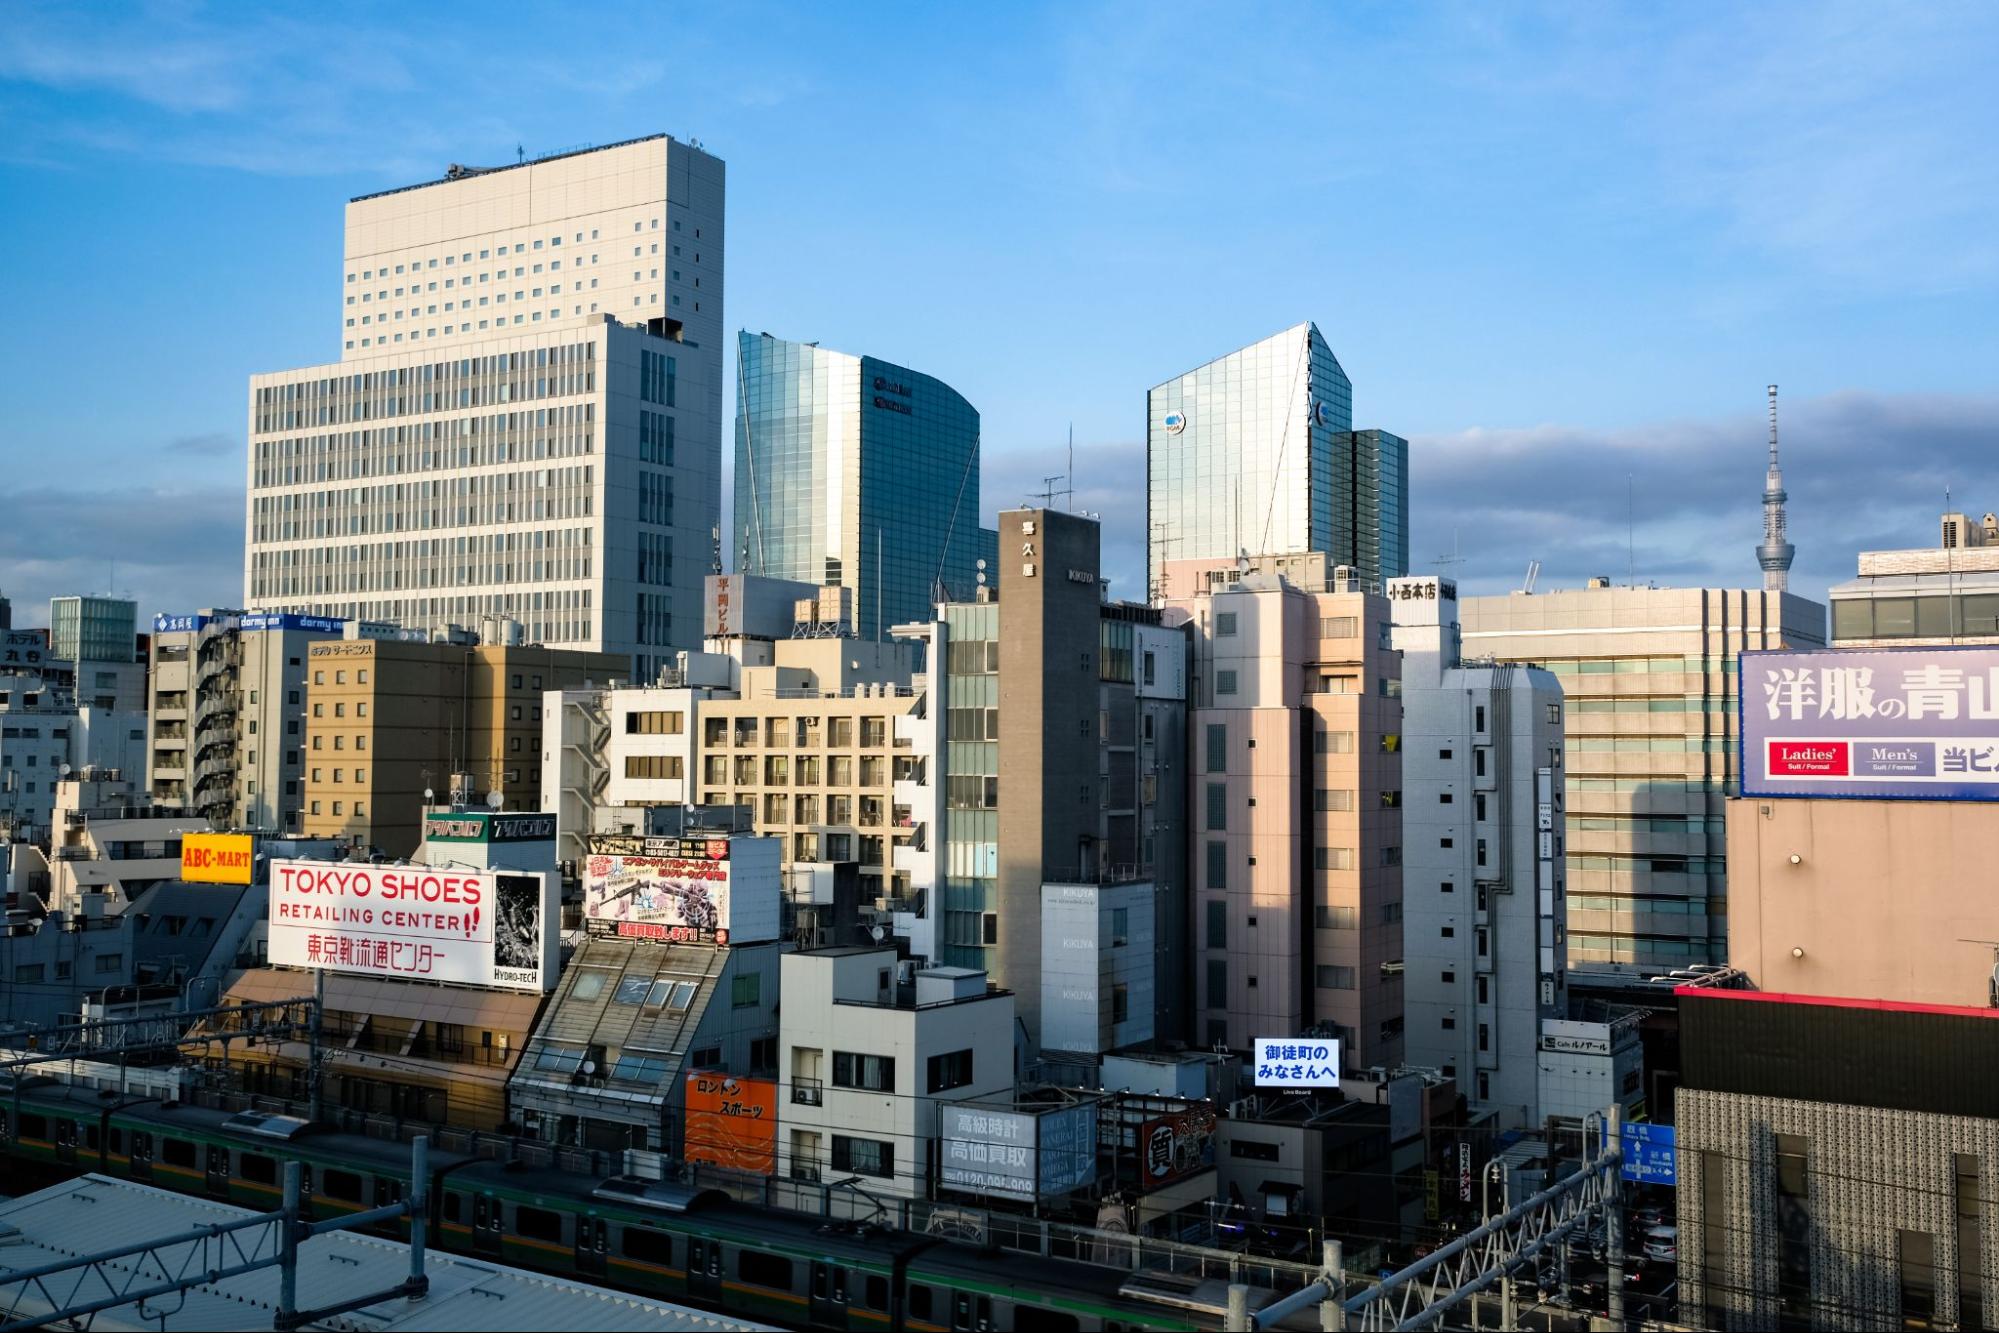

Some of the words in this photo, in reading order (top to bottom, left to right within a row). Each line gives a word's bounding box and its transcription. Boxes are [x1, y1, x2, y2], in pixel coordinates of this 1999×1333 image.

[1389, 582, 1436, 601] 小西本店
[241, 615, 266, 629] dormy
[299, 616, 331, 631] dormy
[6, 633, 41, 645] ホテル
[1781, 748, 1837, 761] Ladies'
[1872, 748, 1918, 761] Men's
[183, 847, 250, 868] ABC-MART
[280, 869, 372, 897] TOKYO
[381, 874, 481, 905] SHOES
[280, 905, 373, 924] RETAILING
[382, 911, 459, 931] CENTER
[307, 934, 446, 973] 東京靴流通センター
[1265, 1044, 1329, 1061] 御徒町の
[1258, 1064, 1336, 1079] みなさんへ
[720, 1101, 763, 1118] スポーツ
[957, 1114, 1019, 1139] 高級時計
[950, 1136, 1027, 1168] 高価買取
